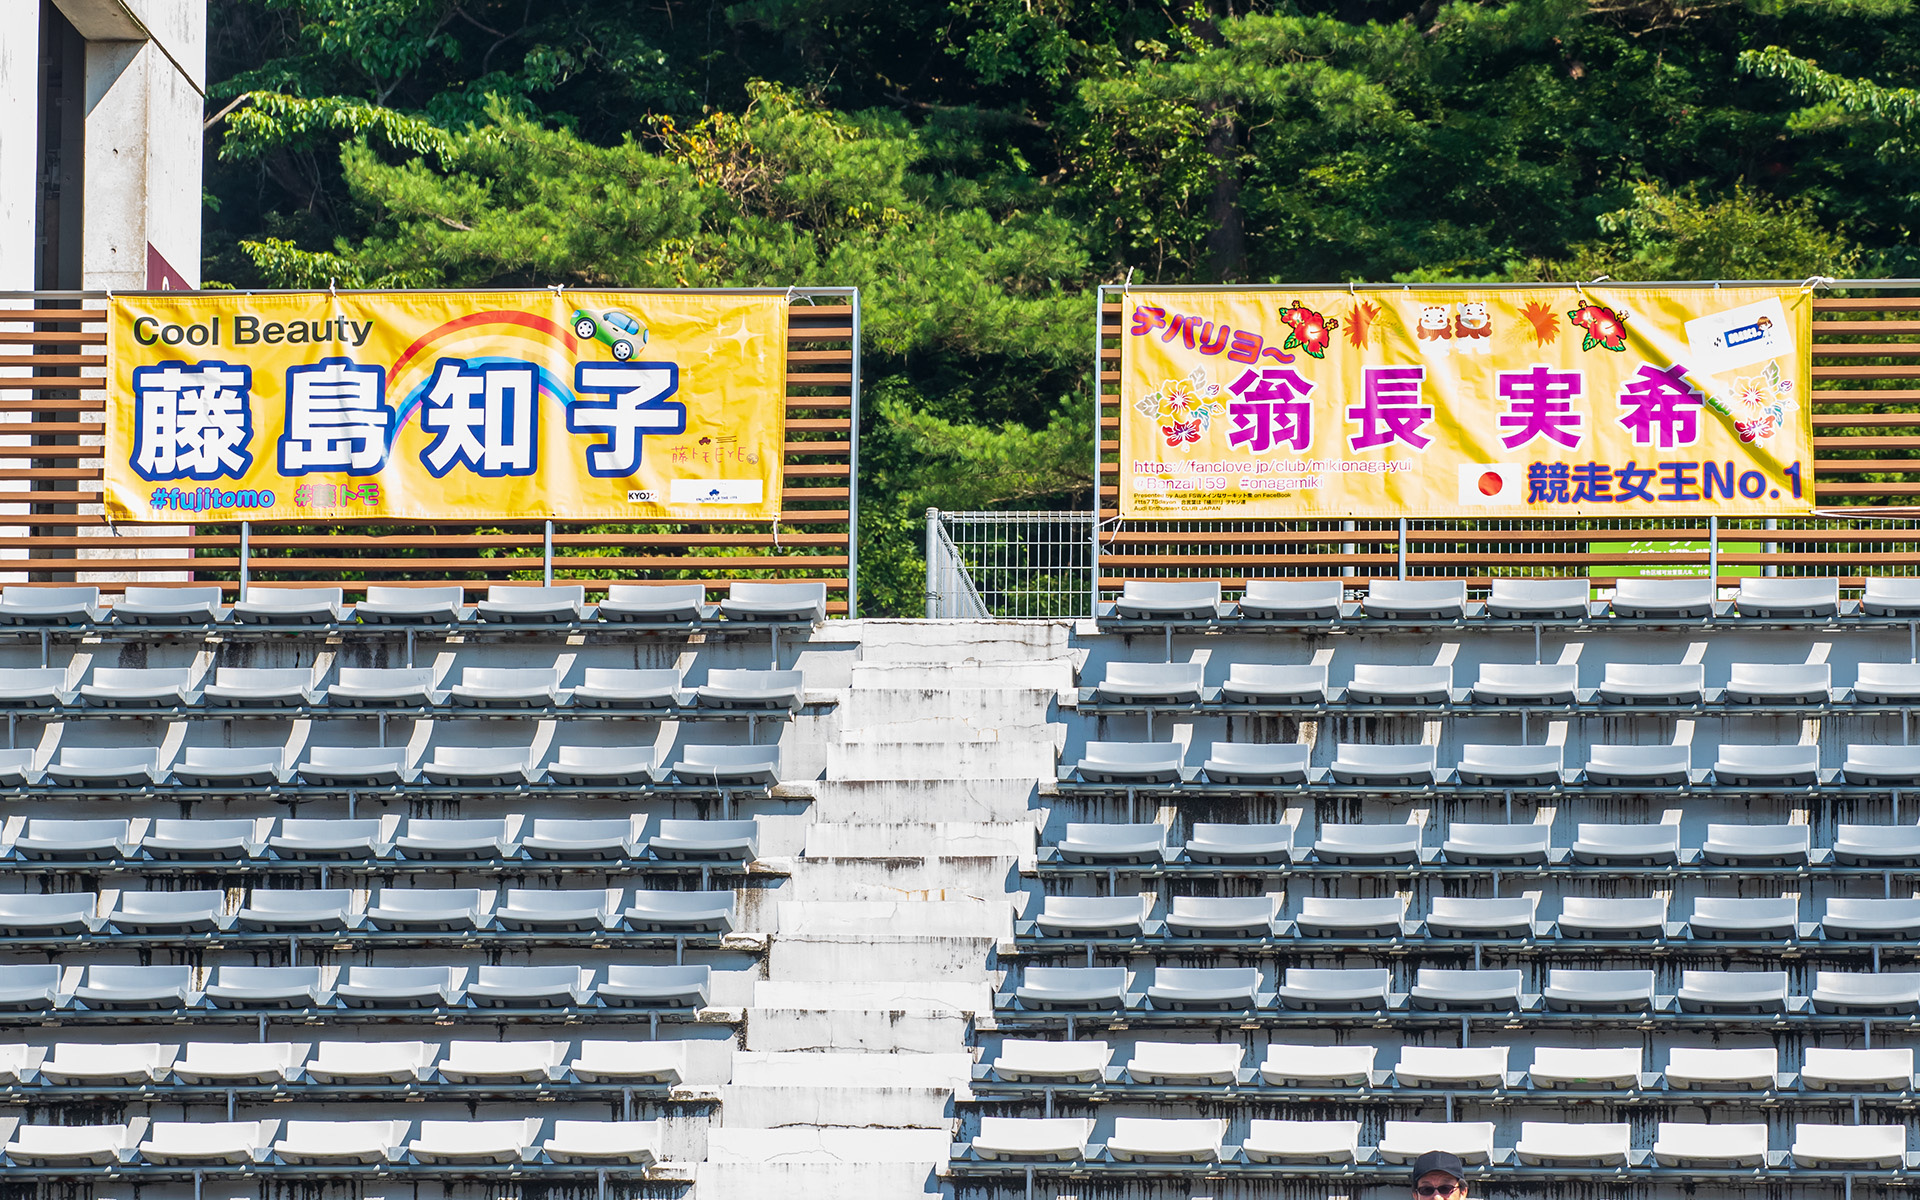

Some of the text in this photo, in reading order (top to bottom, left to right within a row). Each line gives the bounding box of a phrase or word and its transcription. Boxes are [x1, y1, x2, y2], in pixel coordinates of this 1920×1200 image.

[133, 315, 374, 347] Cool Beauty
[129, 356, 687, 482] 藤島知子
[1225, 364, 1706, 453] 翁長実希
[1133, 460, 1412, 474] https://fanclove.jp/club/mikionaga-yui
[1240, 476, 1323, 490] #onagamiki
[1527, 461, 1803, 504] 競走女王No.1
[150, 487, 275, 512] #fujitomo
